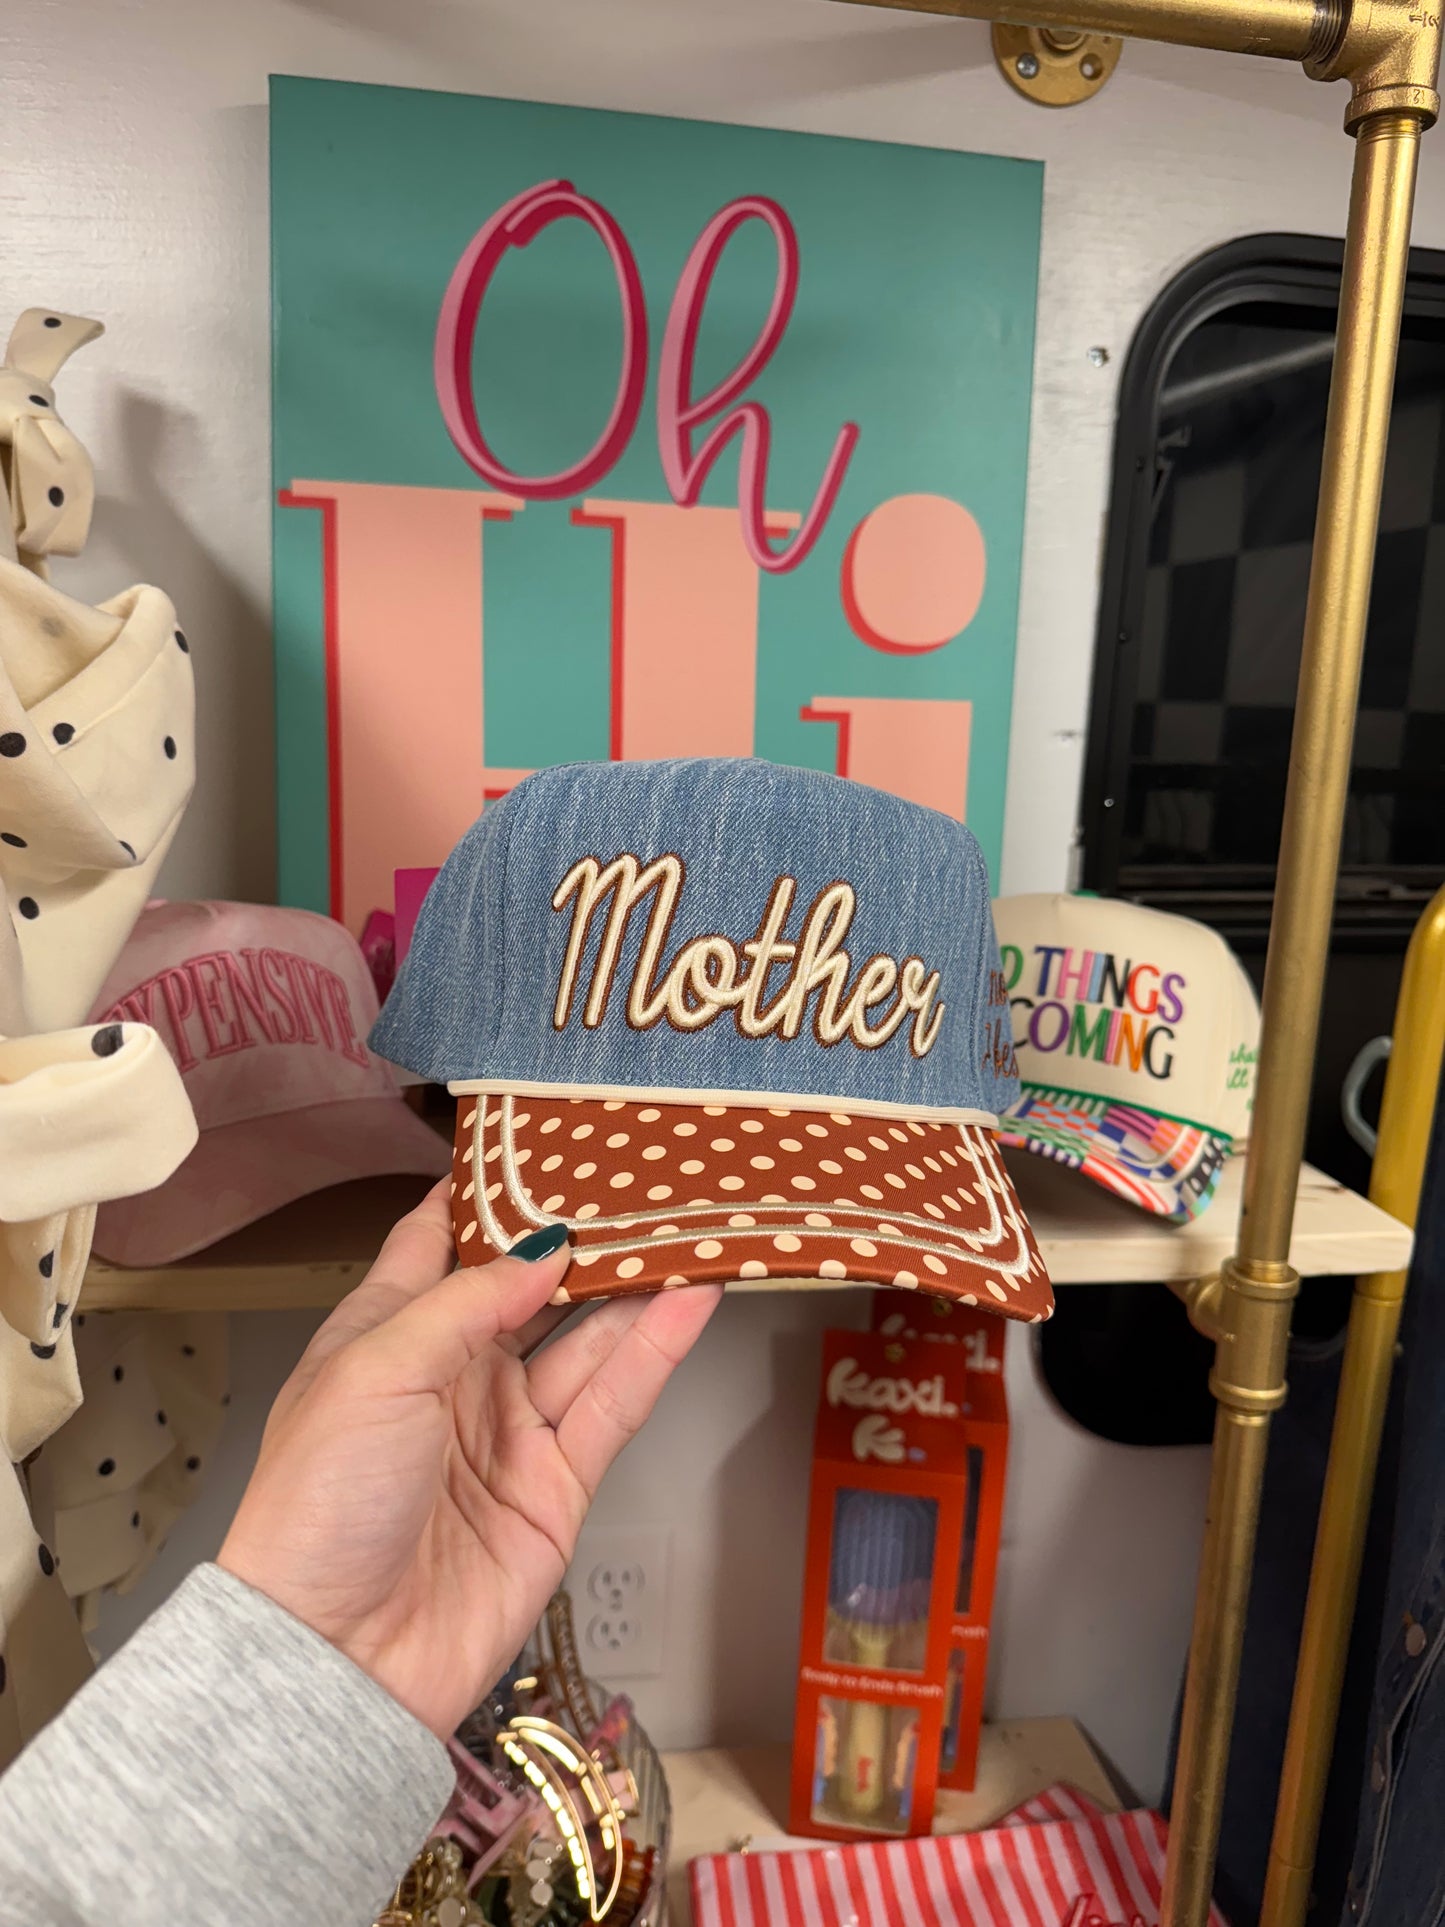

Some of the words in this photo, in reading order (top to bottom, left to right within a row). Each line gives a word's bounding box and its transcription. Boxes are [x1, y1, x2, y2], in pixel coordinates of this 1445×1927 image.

[433, 179, 860, 575] Oh
[99, 947, 371, 1074] PENSIVE
[552, 852, 946, 1058] Mother
[1034, 945, 1186, 1024] THINGS
